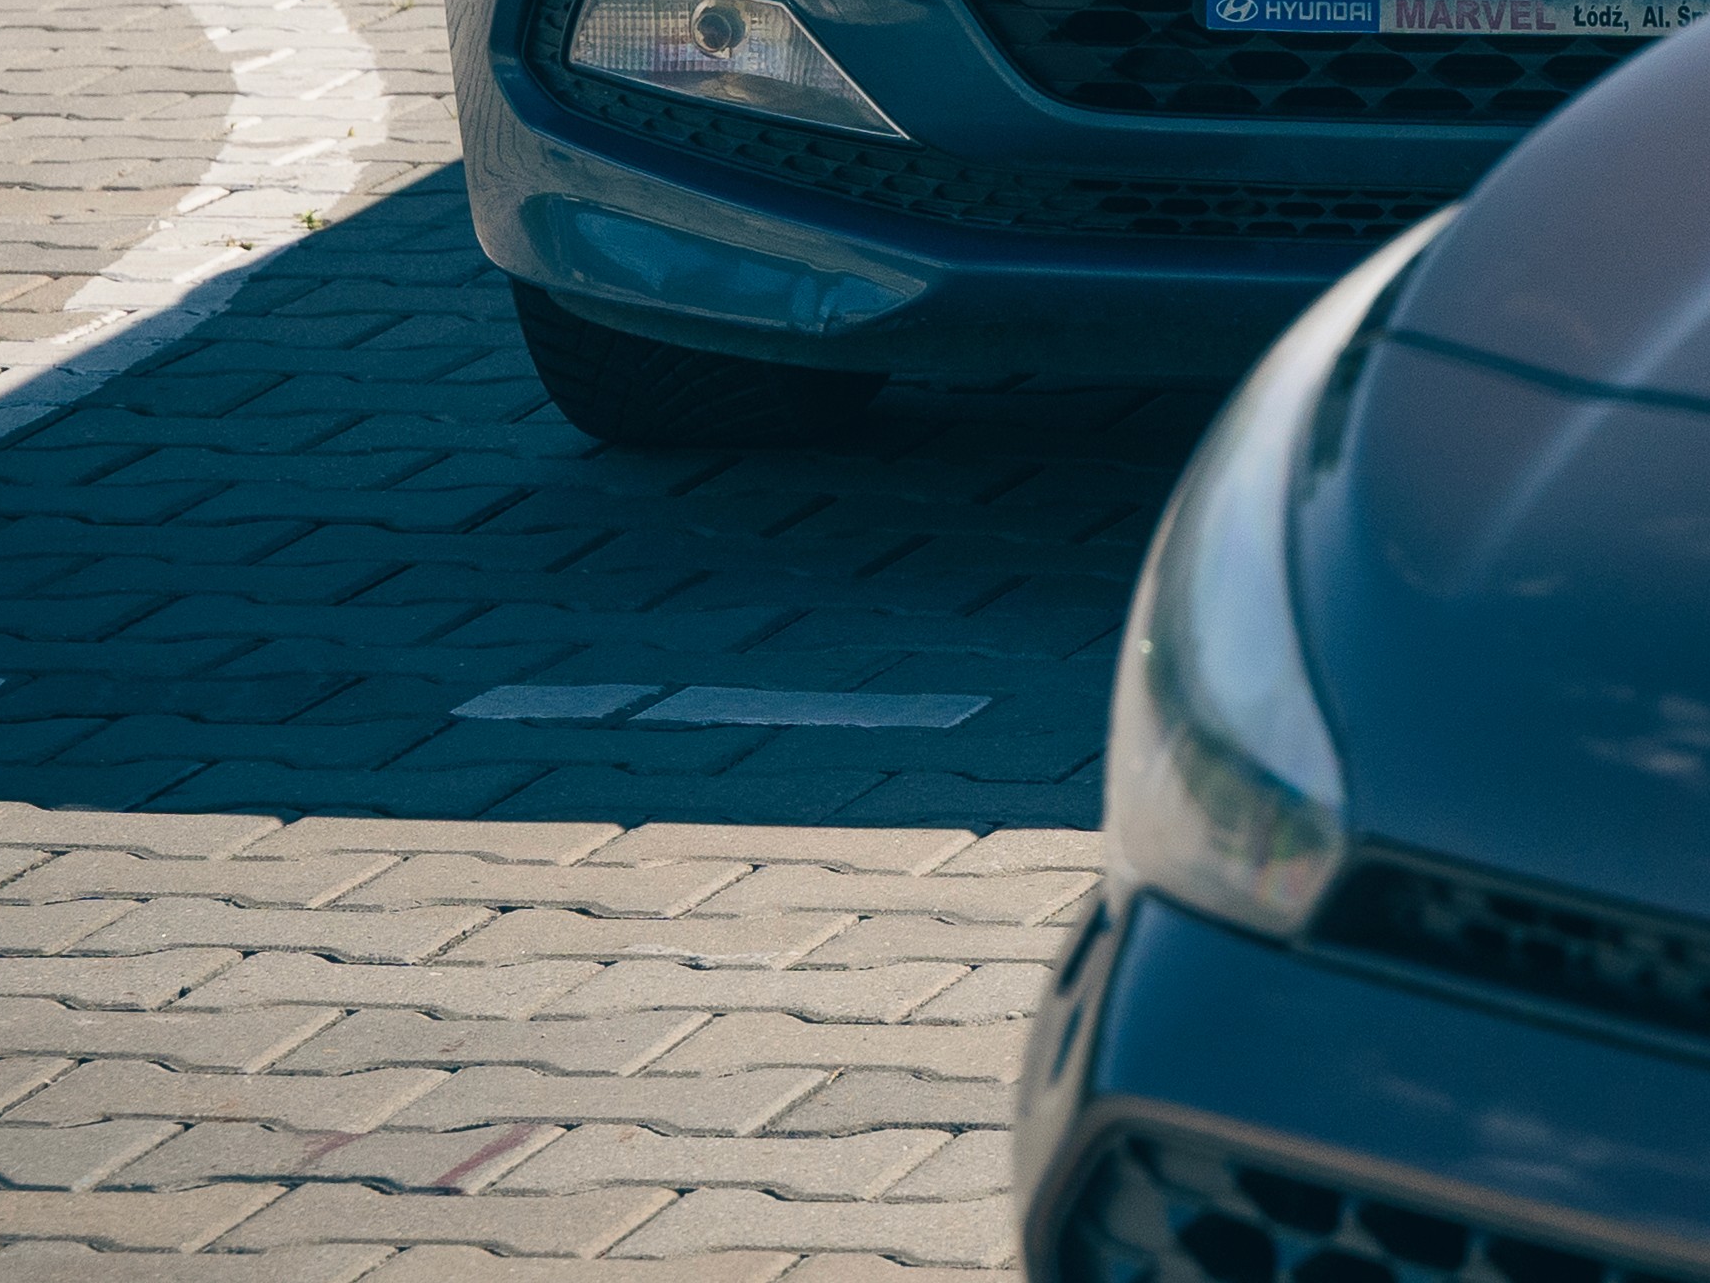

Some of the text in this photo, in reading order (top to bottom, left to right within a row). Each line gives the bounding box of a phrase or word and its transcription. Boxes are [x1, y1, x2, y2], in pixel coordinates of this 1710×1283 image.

[1265, 0, 1373, 23] HYUNDAI
[1572, 4, 1630, 33] Łódź,
[1641, 5, 1671, 28] Al.
